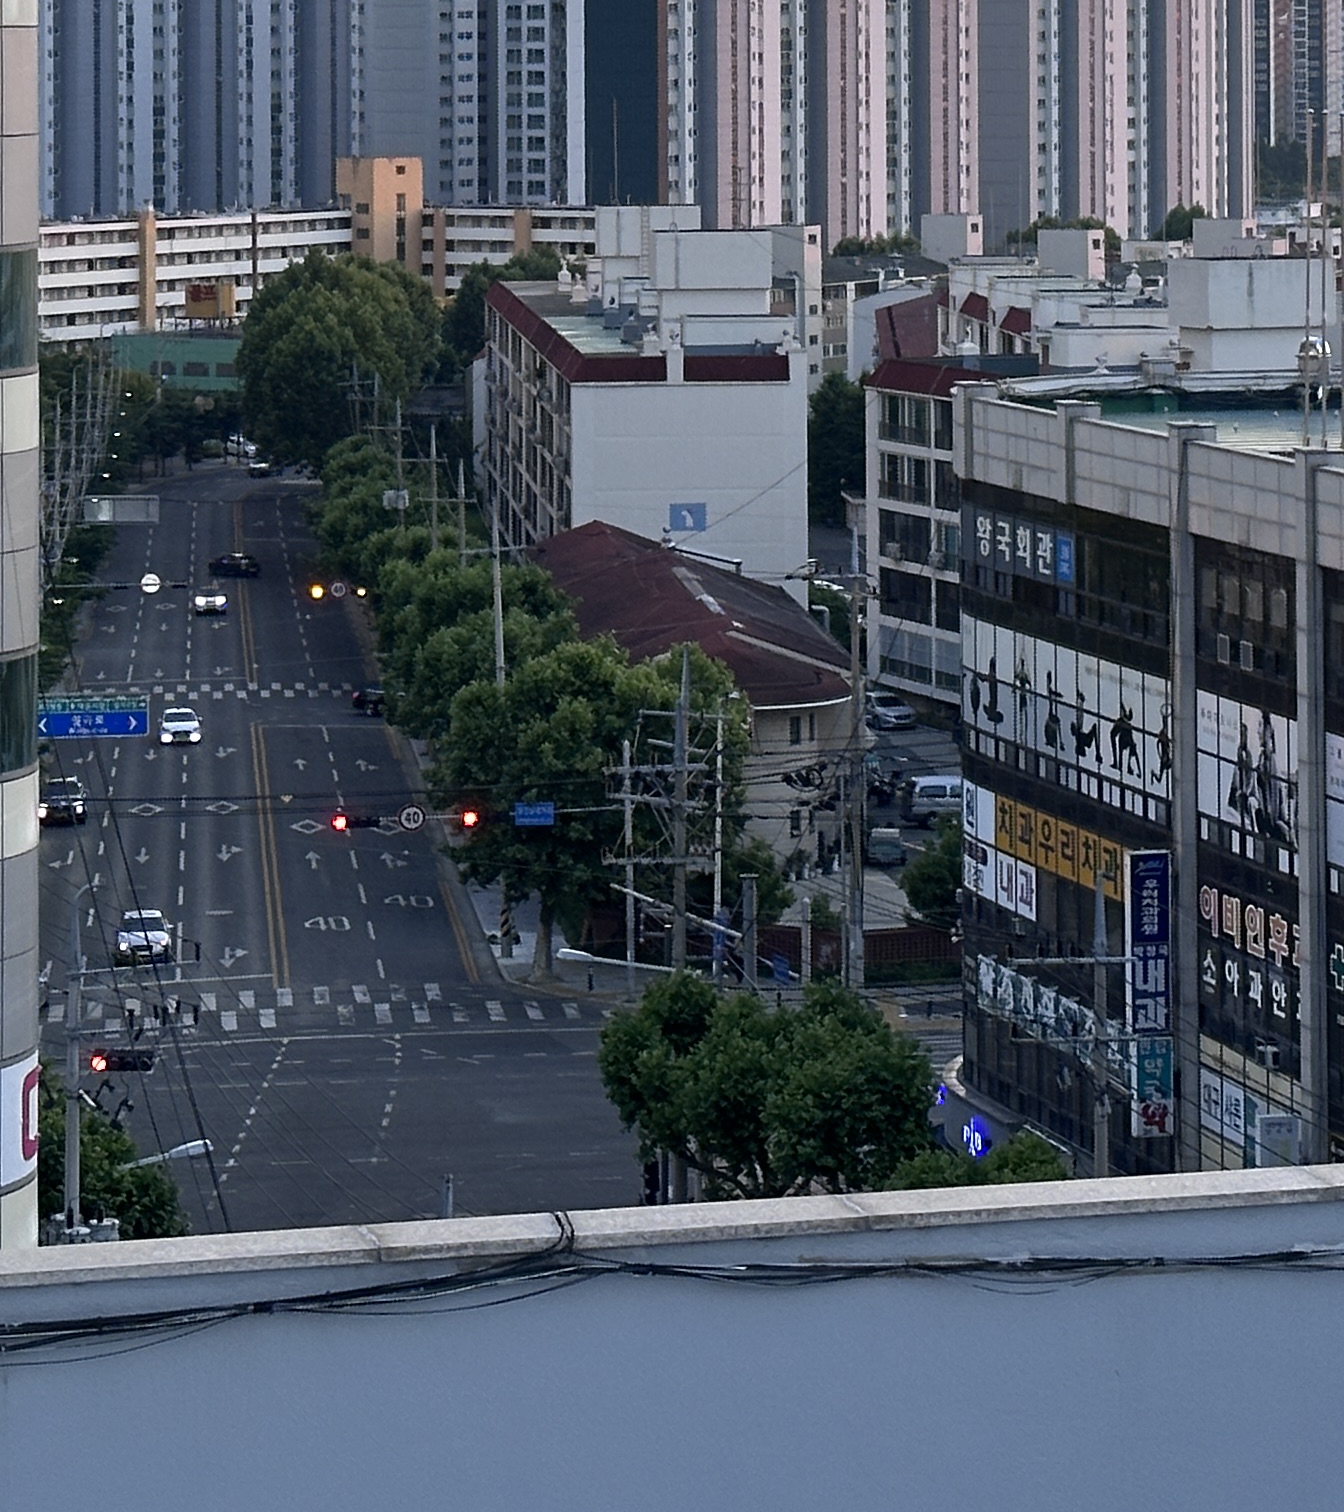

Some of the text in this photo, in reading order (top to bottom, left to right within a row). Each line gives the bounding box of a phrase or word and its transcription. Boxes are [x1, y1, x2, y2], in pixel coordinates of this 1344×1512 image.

[976, 515, 1054, 576] 왕국회관
[384, 894, 435, 909] 40
[304, 915, 352, 931] 40
[1134, 958, 1169, 1031] 내과
